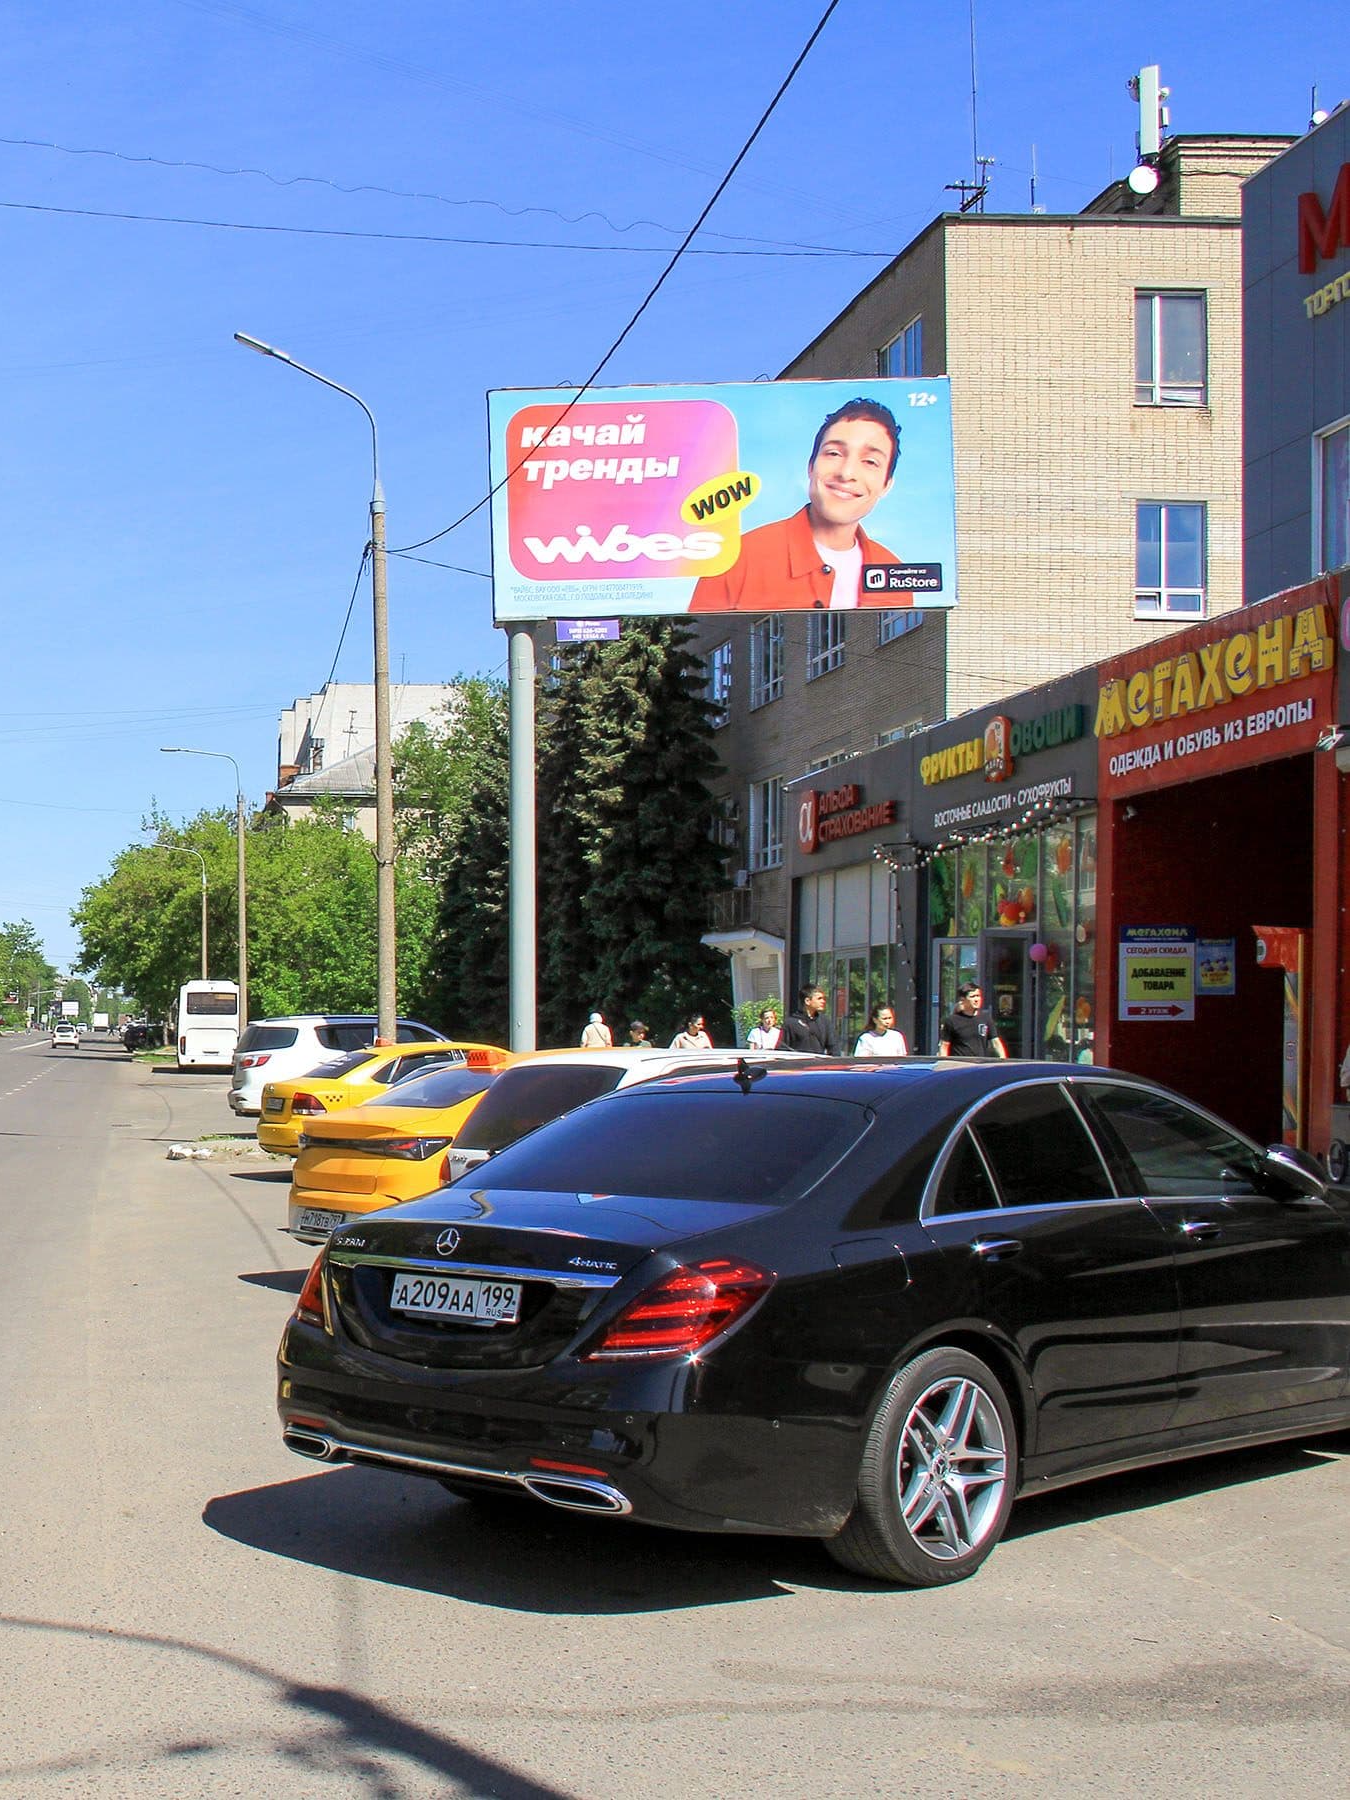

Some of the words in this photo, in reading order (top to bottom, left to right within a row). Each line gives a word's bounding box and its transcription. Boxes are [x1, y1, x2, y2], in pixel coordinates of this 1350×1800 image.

[908, 393, 938, 407] 12+
[521, 414, 646, 448] качай
[522, 455, 680, 490] тренды
[523, 524, 725, 565] wibes
[890, 576, 938, 588] RuStore
[1109, 743, 1162, 777] ОДЕЖДА
[1164, 739, 1173, 757] И
[1176, 727, 1221, 757] ОБУВЬ
[1224, 724, 1243, 744] ИЗ
[1246, 698, 1313, 737] ЕВРОПЫ
[920, 738, 984, 786] ФРУКТЫ
[934, 804, 972, 828] ВОСТОЧНЫЕ
[972, 793, 1012, 817] СЛАДОСТИ
[1017, 777, 1072, 805] СУХОФРУКТЫ
[818, 800, 897, 842] СТРАХОВАНИЕ
[1125, 946, 1158, 955] СЕГОДНЯ
[1158, 946, 1188, 955] СКИДКА
[1131, 967, 1187, 979] ДОБАВЛЕНИЕ
[1142, 980, 1175, 991] ТОВАРА
[1140, 1007, 1146, 1015] 2
[396, 1279, 474, 1313] А209АА
[482, 1285, 514, 1308] 199
[485, 1308, 502, 1318] RUS
